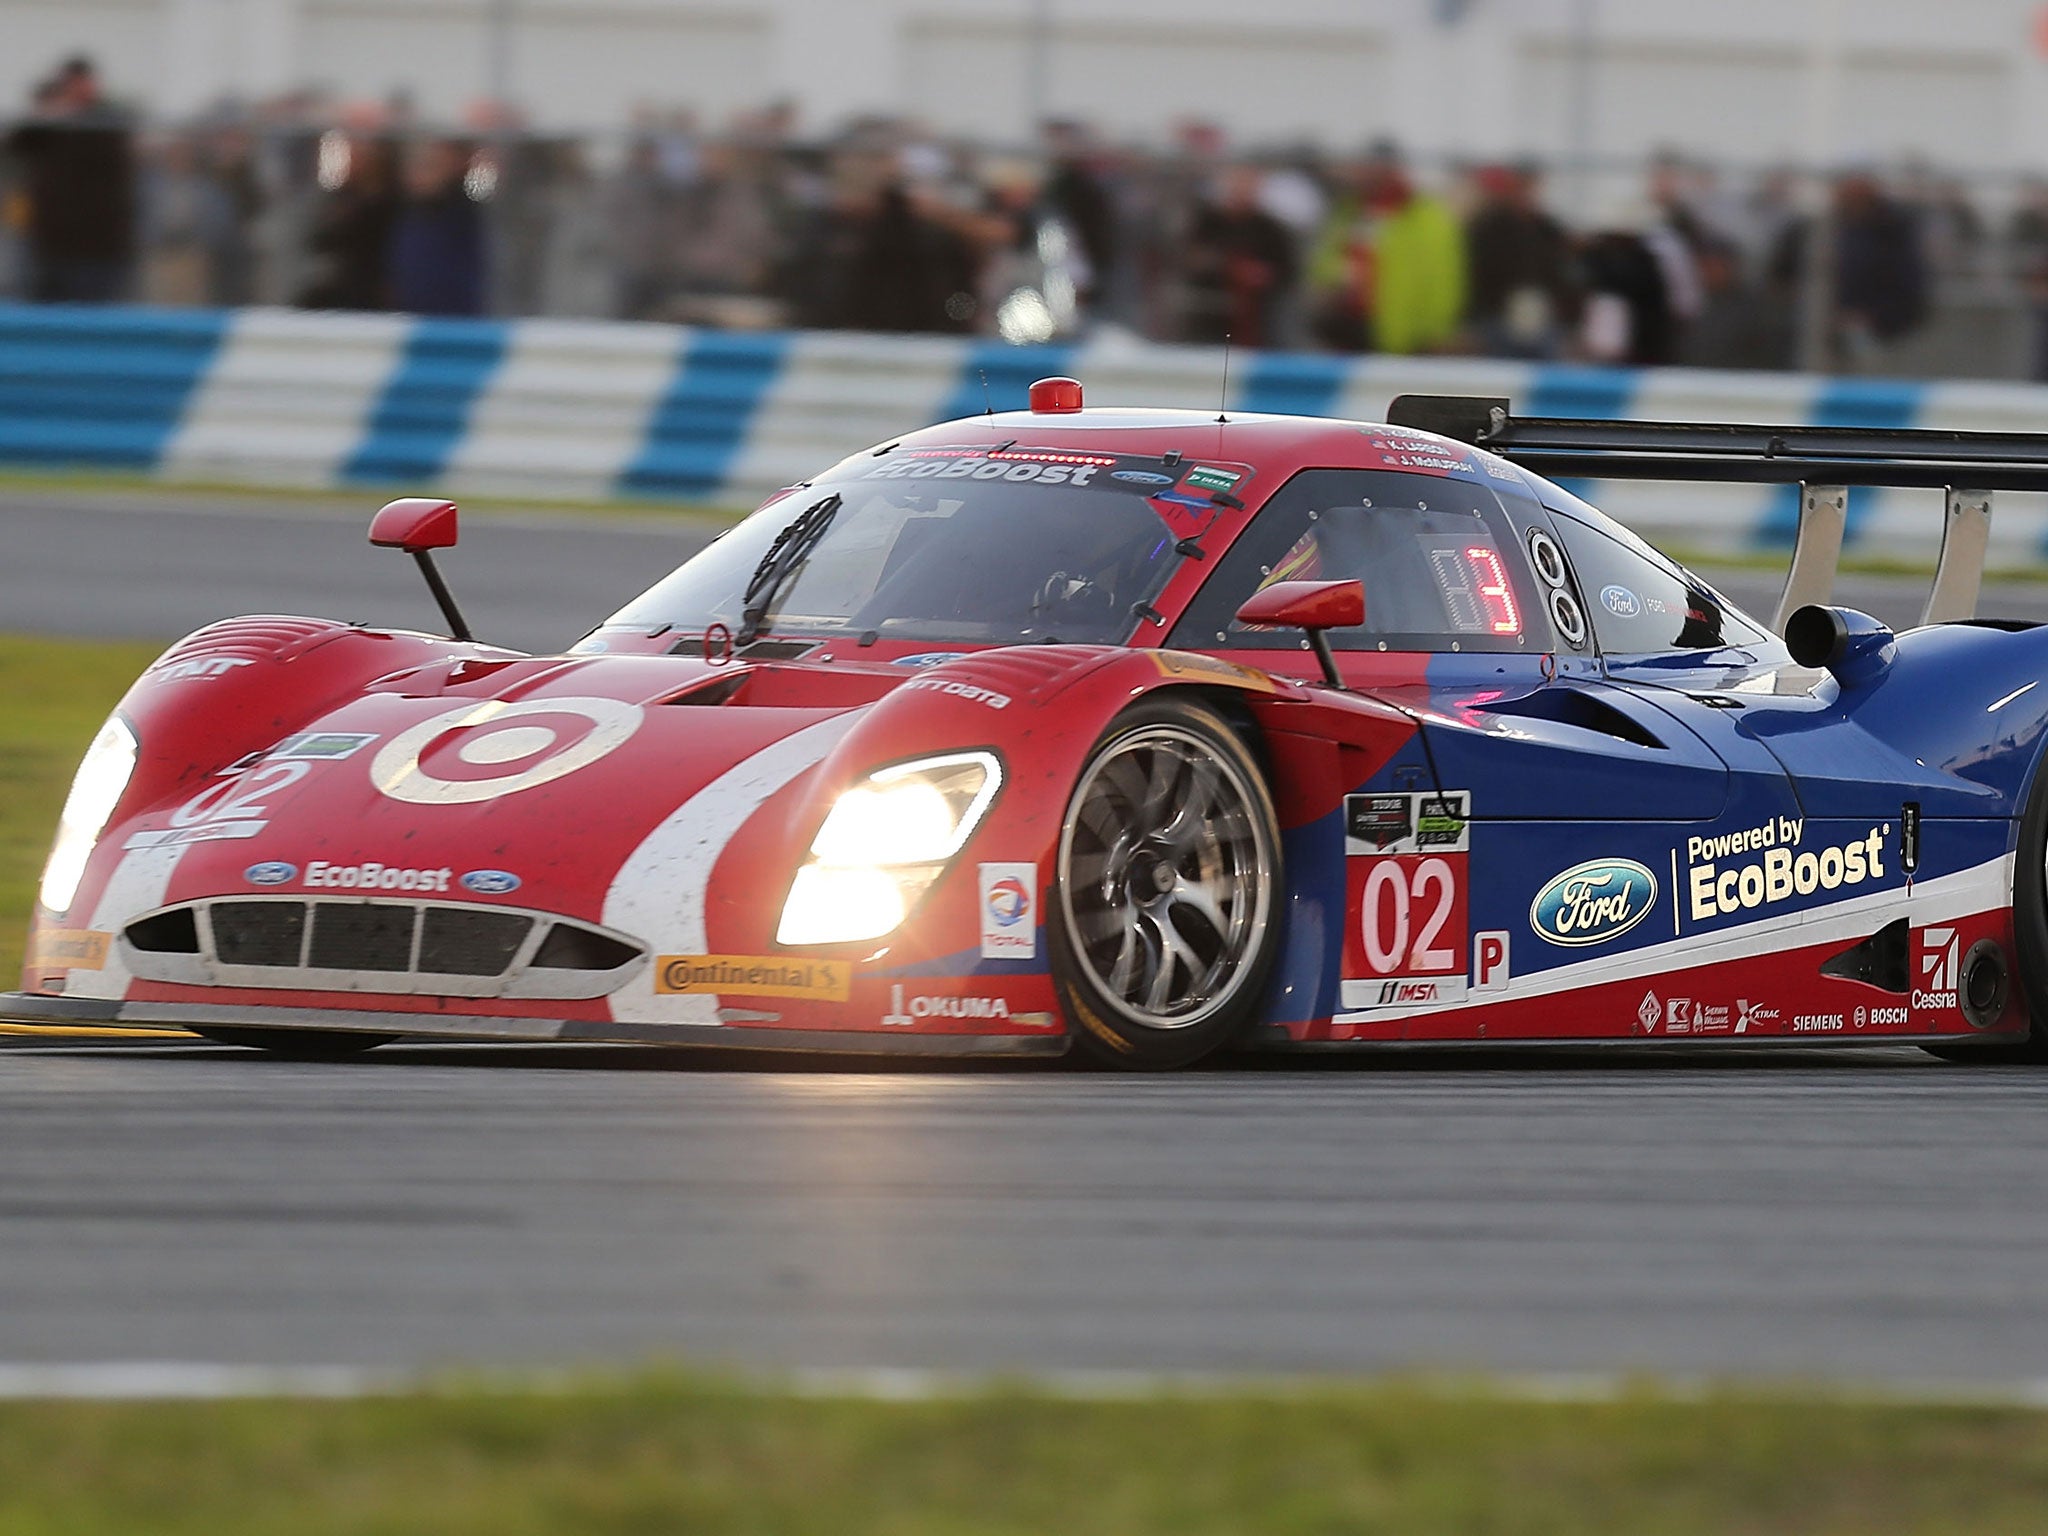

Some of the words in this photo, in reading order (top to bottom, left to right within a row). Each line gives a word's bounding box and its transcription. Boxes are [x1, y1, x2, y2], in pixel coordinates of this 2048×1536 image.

[1400, 455, 1413, 466] J.
[1404, 441, 1452, 456] LARSON
[864, 458, 1099, 486] EcoBoost
[1466, 547, 1519, 633] 3
[169, 760, 312, 828] 02
[1687, 815, 1775, 865] Powered
[1779, 814, 1803, 847] by
[303, 861, 453, 892] EcoBoost
[1362, 857, 1456, 974] 02
[982, 933, 1034, 947] TOTAL
[1480, 938, 1503, 985] P
[665, 959, 813, 991] Continental
[1397, 983, 1438, 1001] IMSA
[1911, 988, 1957, 1011] Cessna
[908, 996, 1009, 1019] OKUMA
[1870, 1007, 1909, 1025] BOSCH
[1793, 1014, 1844, 1032] SIEMENS
